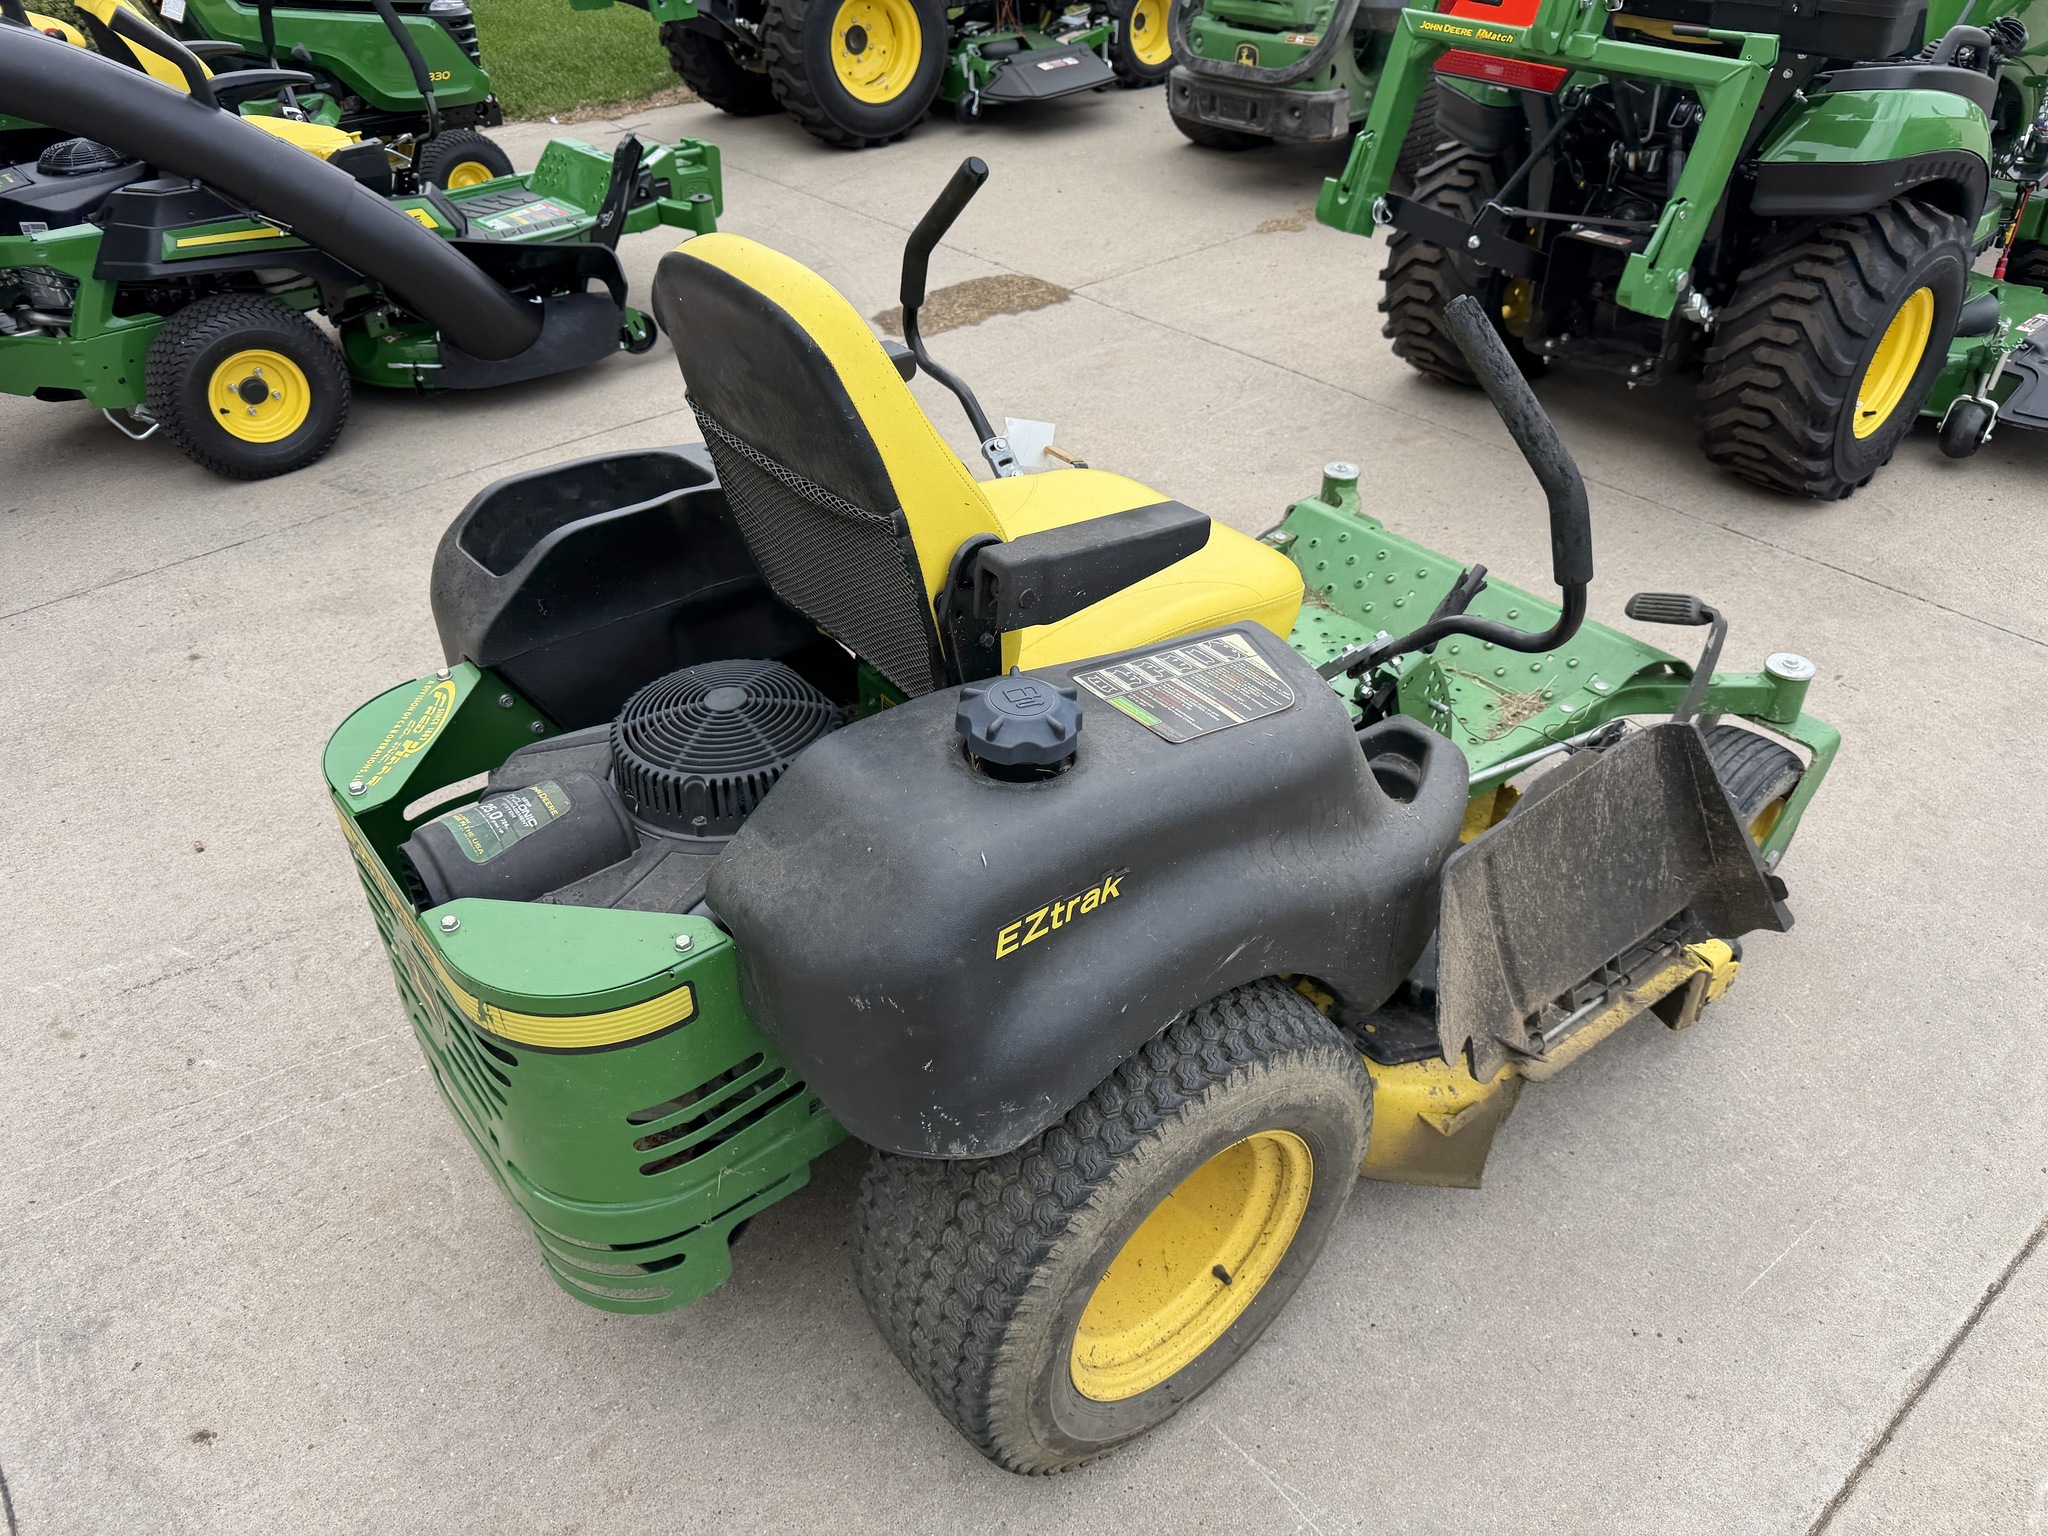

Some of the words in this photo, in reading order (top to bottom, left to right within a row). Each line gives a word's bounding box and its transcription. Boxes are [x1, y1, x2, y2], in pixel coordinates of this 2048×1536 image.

[1420, 20, 1443, 32] JOHN
[1443, 24, 1473, 37] DEERE
[407, 685, 432, 712] DIVISION
[413, 691, 448, 734] FRED
[479, 803, 504, 820] 25.0
[539, 792, 559, 816] DEERE
[472, 837, 484, 855] USA
[995, 875, 1125, 961] EZtrak
